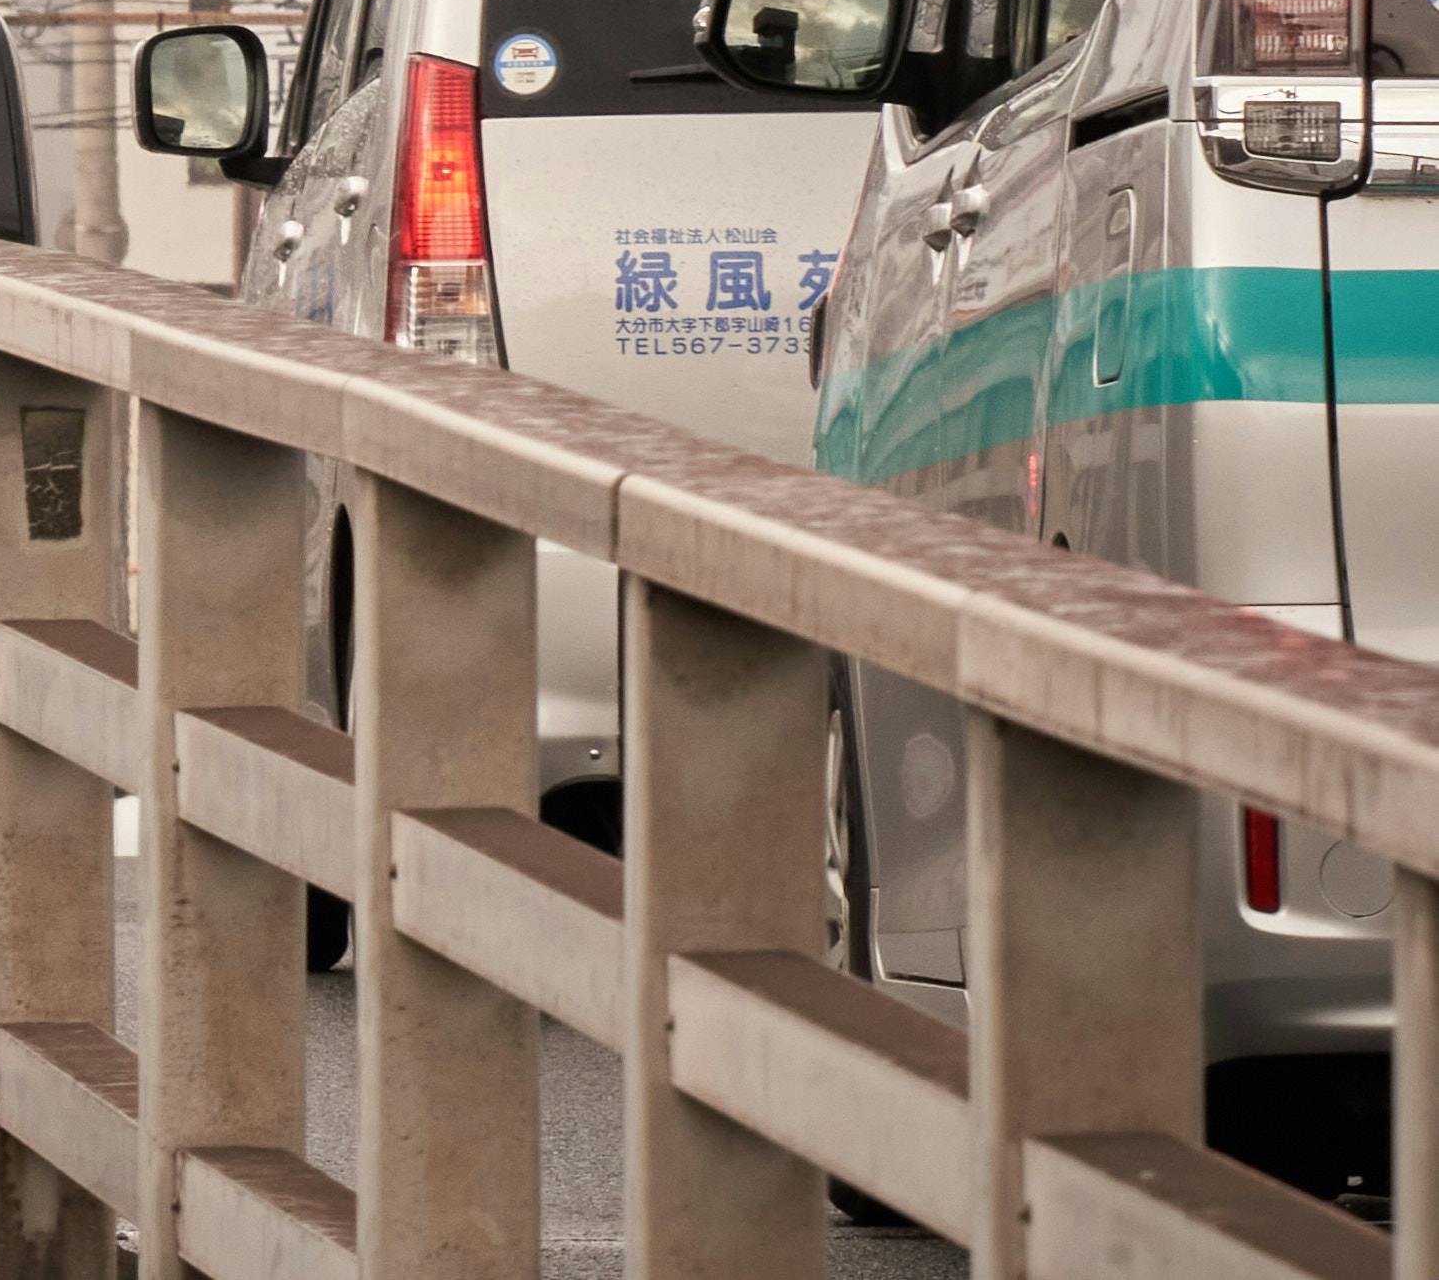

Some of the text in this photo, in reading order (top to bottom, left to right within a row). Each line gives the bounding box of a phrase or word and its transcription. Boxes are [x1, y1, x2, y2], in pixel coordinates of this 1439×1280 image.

[615, 227, 778, 245] 社会福祉法人松山会
